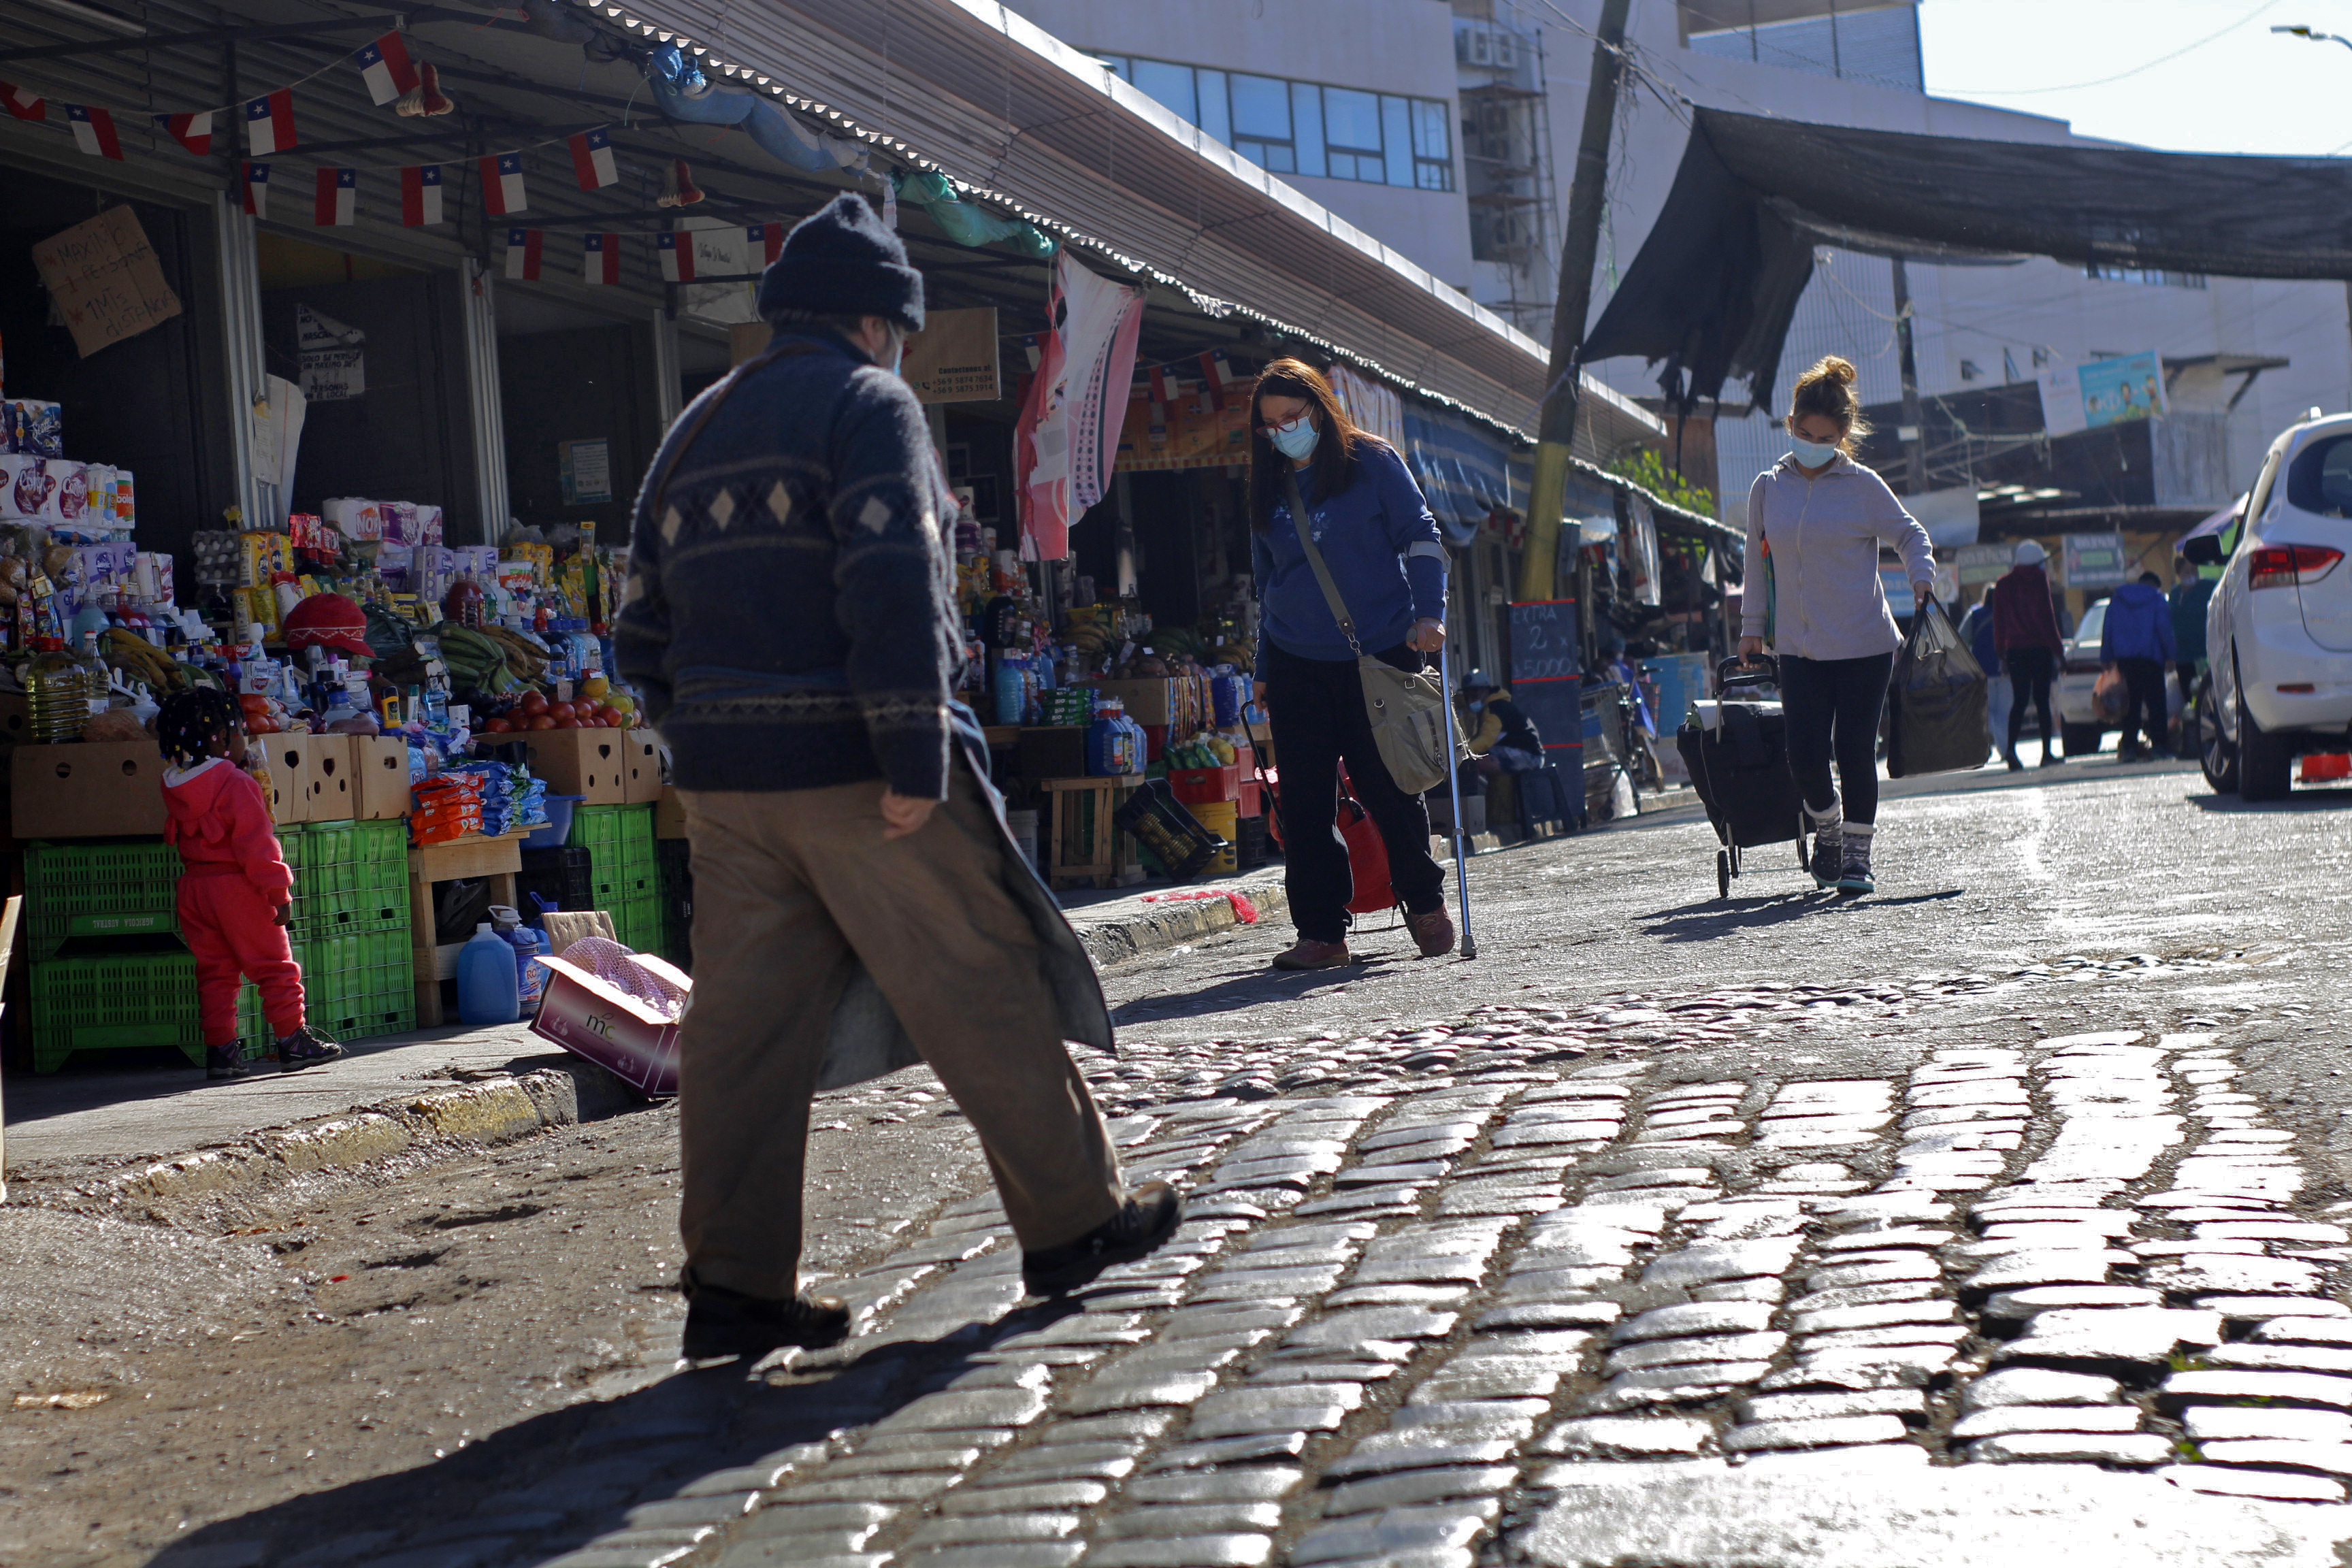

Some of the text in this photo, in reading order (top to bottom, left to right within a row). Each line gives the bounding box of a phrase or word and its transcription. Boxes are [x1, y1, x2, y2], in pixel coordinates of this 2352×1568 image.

[1513, 605, 1558, 624] EXTRA
[1530, 625, 1548, 650] 2
[93, 917, 154, 928] AGRICOLA AUSTRAL
